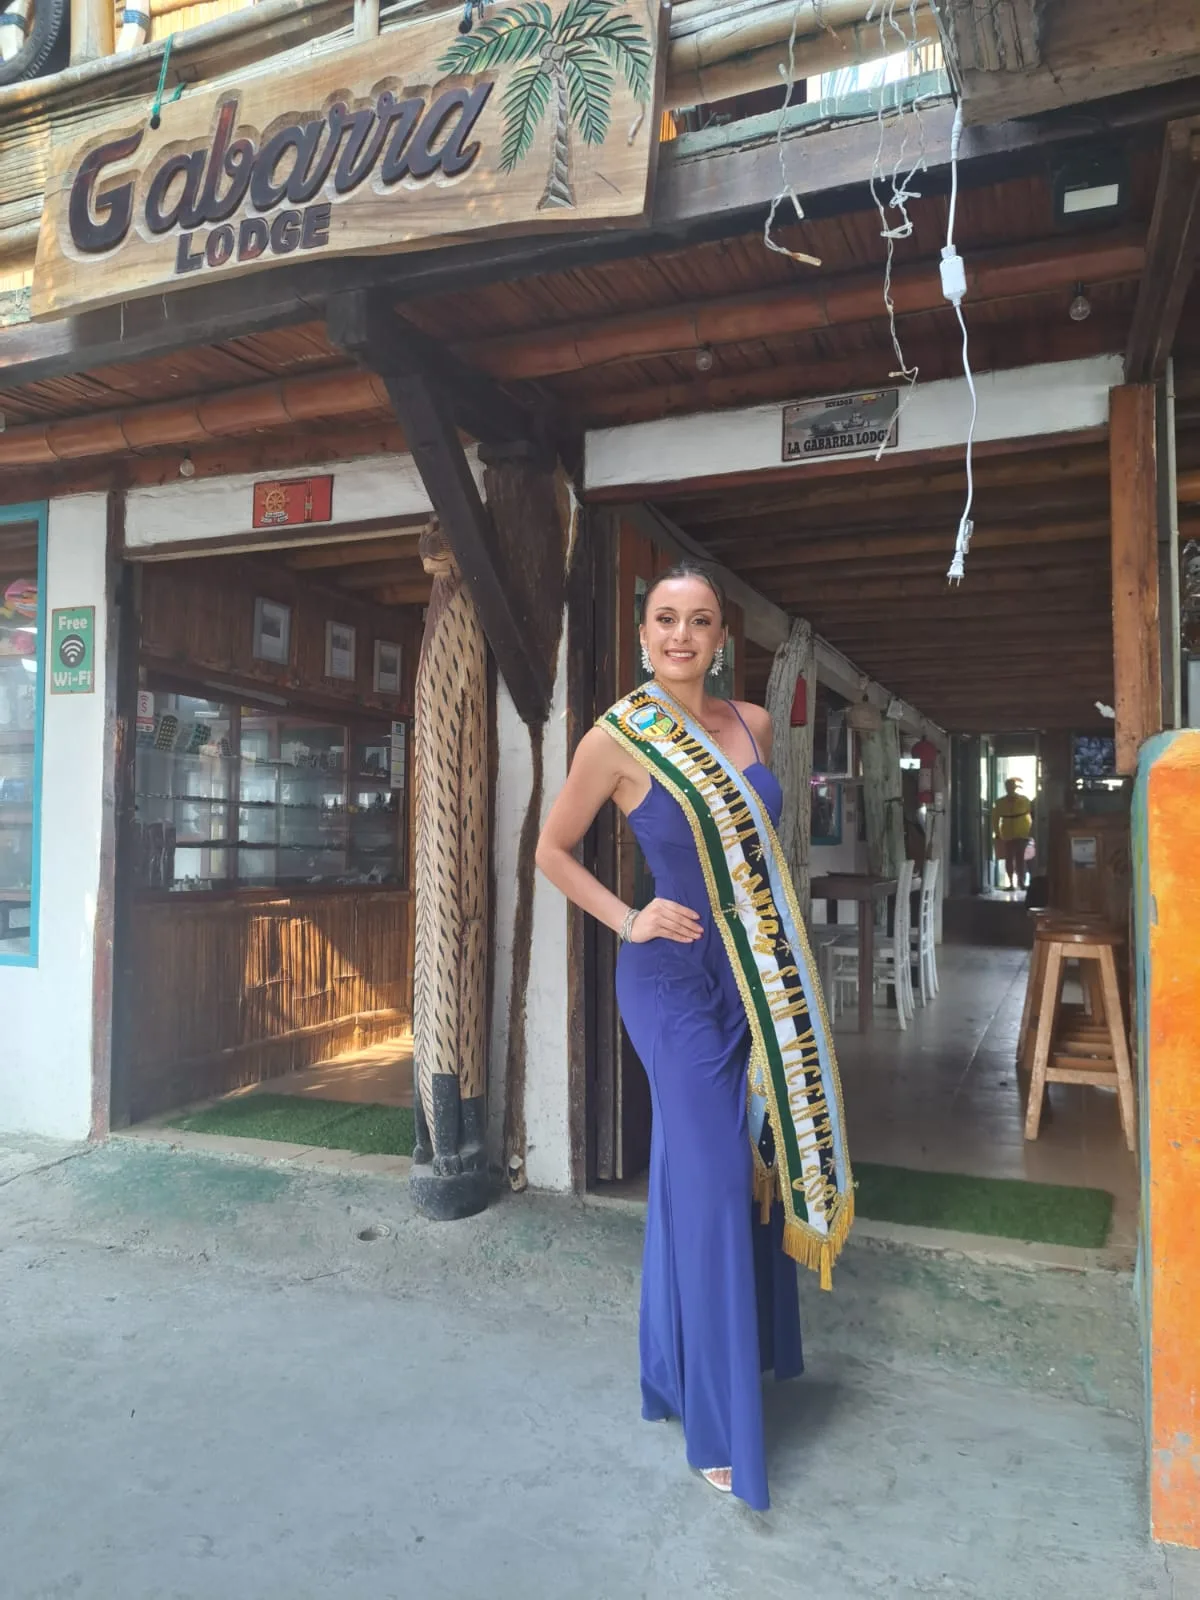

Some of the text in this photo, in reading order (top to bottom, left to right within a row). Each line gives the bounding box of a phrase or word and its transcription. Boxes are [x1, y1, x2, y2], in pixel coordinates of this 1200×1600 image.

[69, 81, 494, 253] Gabarra
[175, 202, 332, 274] LODGE
[788, 442, 800, 454] LA
[803, 434, 855, 451] GABARRA
[58, 615, 88, 630] Free
[54, 670, 92, 687] Wi-Fi
[661, 733, 759, 850] VIRREINA
[731, 861, 779, 956] CANTON
[760, 965, 809, 1022] SAN
[780, 1026, 833, 1161] VICENTE
